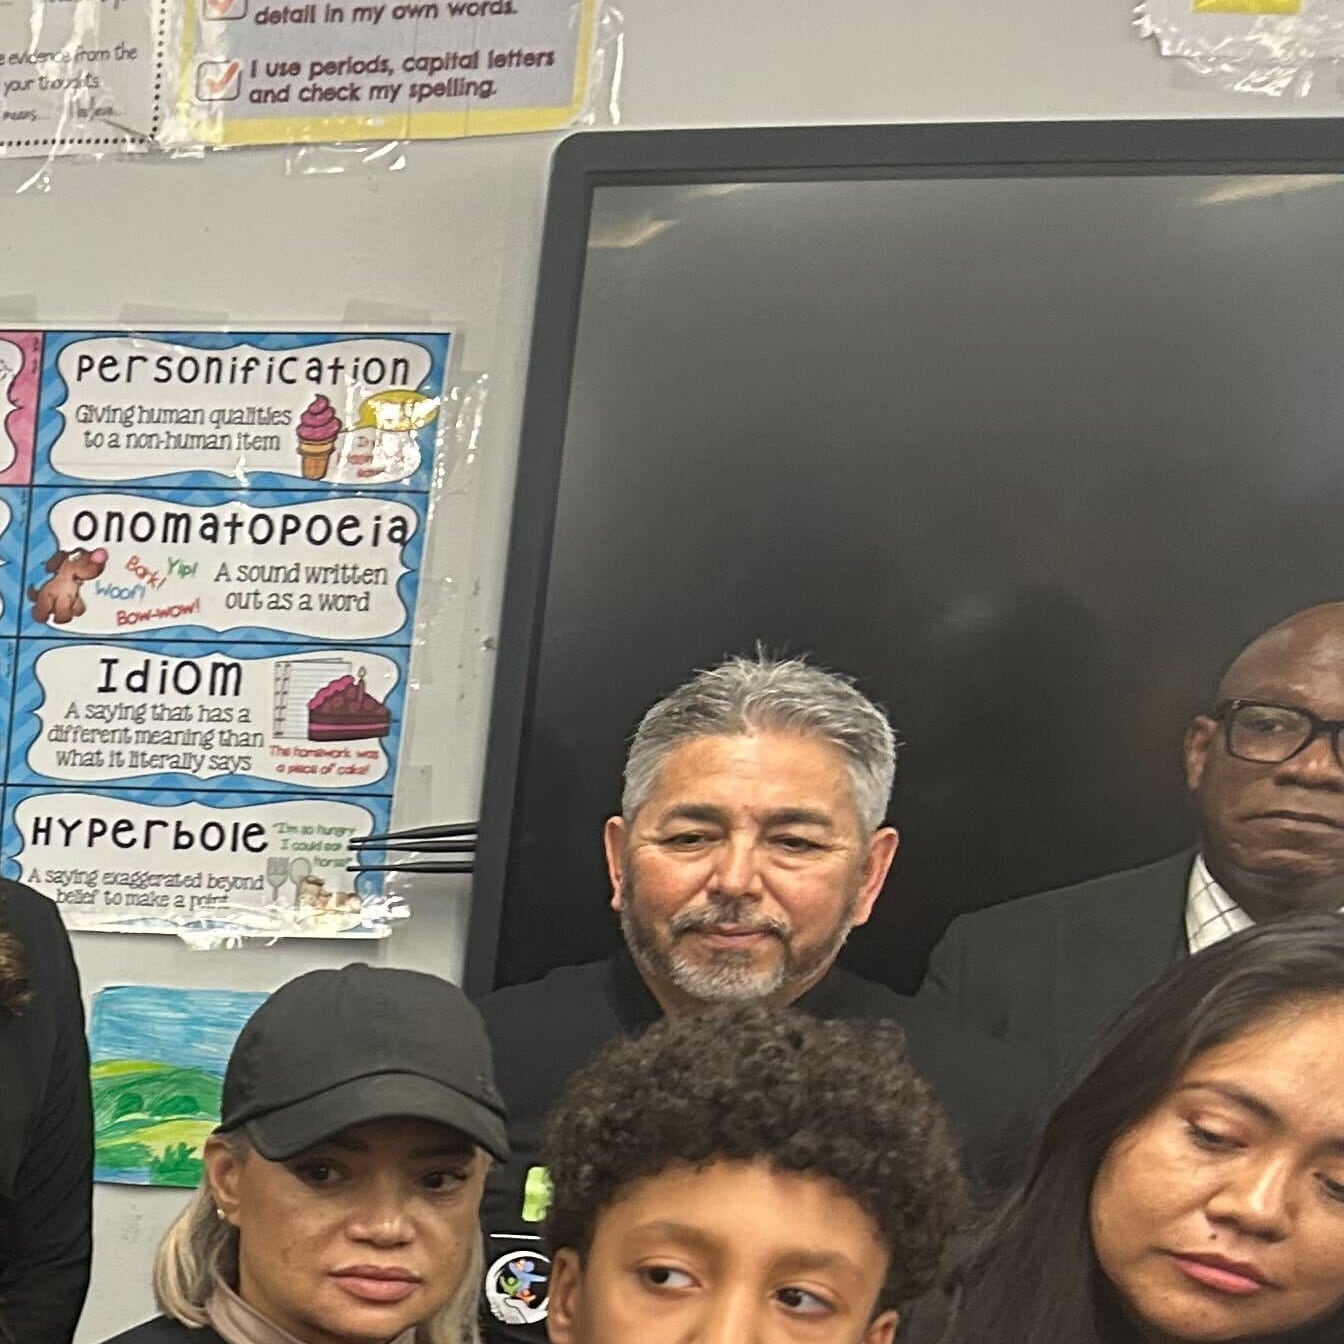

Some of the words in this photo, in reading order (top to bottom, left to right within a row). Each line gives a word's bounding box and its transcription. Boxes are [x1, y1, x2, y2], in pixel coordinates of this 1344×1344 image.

[255, 3, 315, 25] detail
[324, 3, 344, 23] in
[352, 4, 384, 25] my
[392, 2, 439, 20] own
[449, 0, 519, 16] words.
[75, 45, 110, 63] from
[115, 41, 138, 61] the
[265, 60, 301, 77] use
[308, 53, 395, 82] periods,
[402, 50, 479, 77] capital
[487, 48, 555, 70] letters
[4, 77, 36, 97] your
[249, 84, 290, 104] and
[298, 81, 360, 103] check
[368, 83, 401, 104] my
[408, 78, 497, 102] spelling.
[76, 353, 410, 386] Personification
[76, 404, 135, 428] Giving
[138, 404, 204, 426] human
[210, 405, 293, 429] qualities
[84, 430, 108, 449] to
[109, 435, 121, 449] a
[126, 431, 232, 451] non-human
[237, 431, 280, 451] item
[214, 562, 235, 583] A
[237, 562, 301, 584] sound
[304, 564, 389, 586] written
[225, 591, 262, 611] out
[266, 594, 293, 611] as
[297, 594, 313, 611] a
[316, 591, 370, 612] word
[97, 657, 243, 697] Idiom
[64, 702, 80, 720] A
[85, 704, 145, 725] saying
[151, 703, 193, 722] that
[198, 704, 234, 723] has
[239, 708, 252, 723] a
[47, 724, 133, 744] different
[135, 728, 213, 750] meaning
[218, 729, 265, 748] than
[55, 749, 104, 768] what
[110, 750, 125, 768] it
[129, 750, 206, 774] literally
[210, 753, 253, 774] says
[31, 816, 269, 853] Hyperbole
[28, 868, 42, 884] A
[45, 868, 97, 888] saying
[102, 869, 202, 891] exaggerated
[207, 871, 264, 892] beyond
[57, 887, 102, 904] belief
[105, 889, 121, 906] to
[124, 889, 169, 908] make
[174, 892, 185, 908] a
